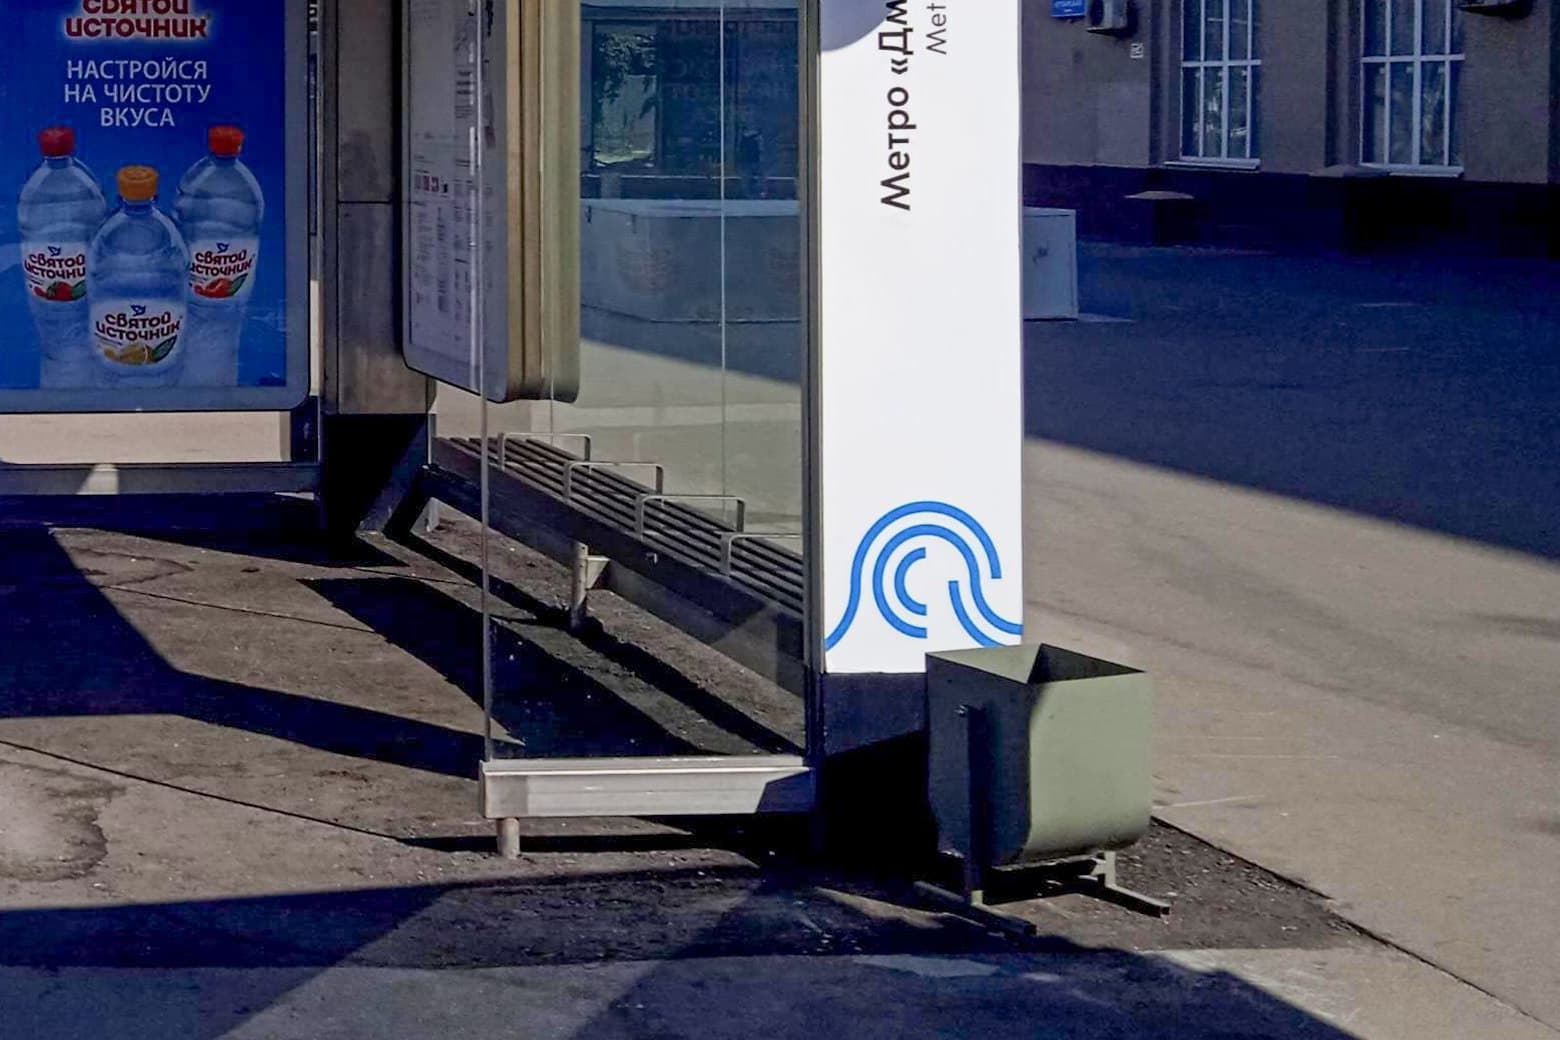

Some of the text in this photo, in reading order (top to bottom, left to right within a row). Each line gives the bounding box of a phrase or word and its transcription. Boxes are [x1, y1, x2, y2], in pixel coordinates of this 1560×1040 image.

[67, 57, 207, 79] НАСТРОЙСЯ
[64, 84, 211, 103] НА ЧИСТОТУ
[100, 108, 176, 127] ВКУСА
[880, 86, 917, 211] Метро
